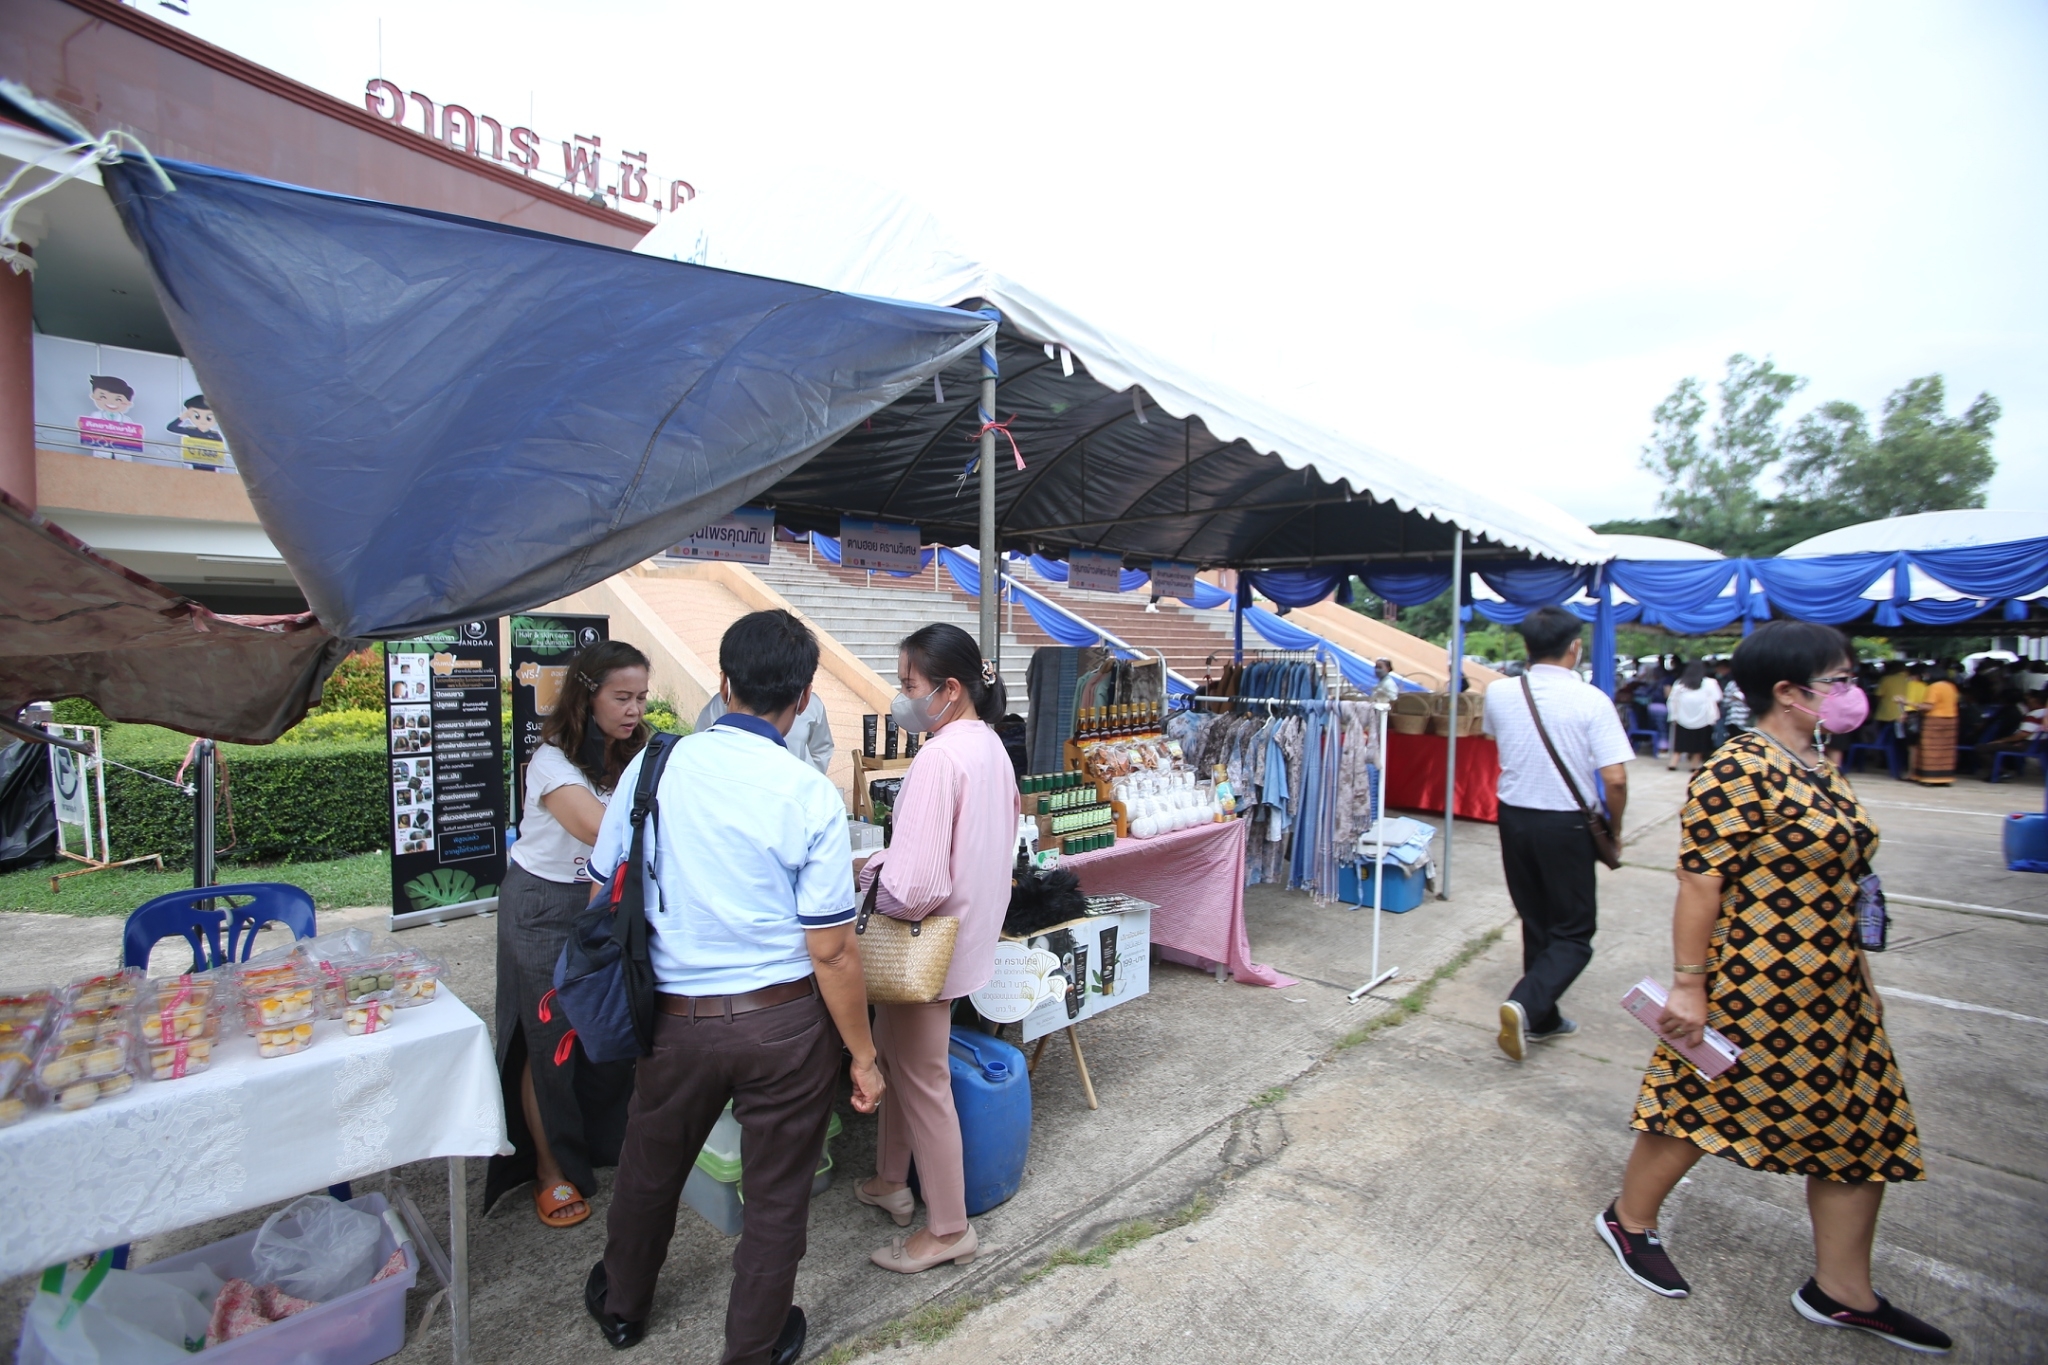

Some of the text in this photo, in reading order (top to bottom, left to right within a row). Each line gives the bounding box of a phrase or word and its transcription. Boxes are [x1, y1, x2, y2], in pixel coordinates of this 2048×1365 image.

[365, 79, 539, 170] อาคาร
[880, 542, 916, 555] ครามวิเศษ
